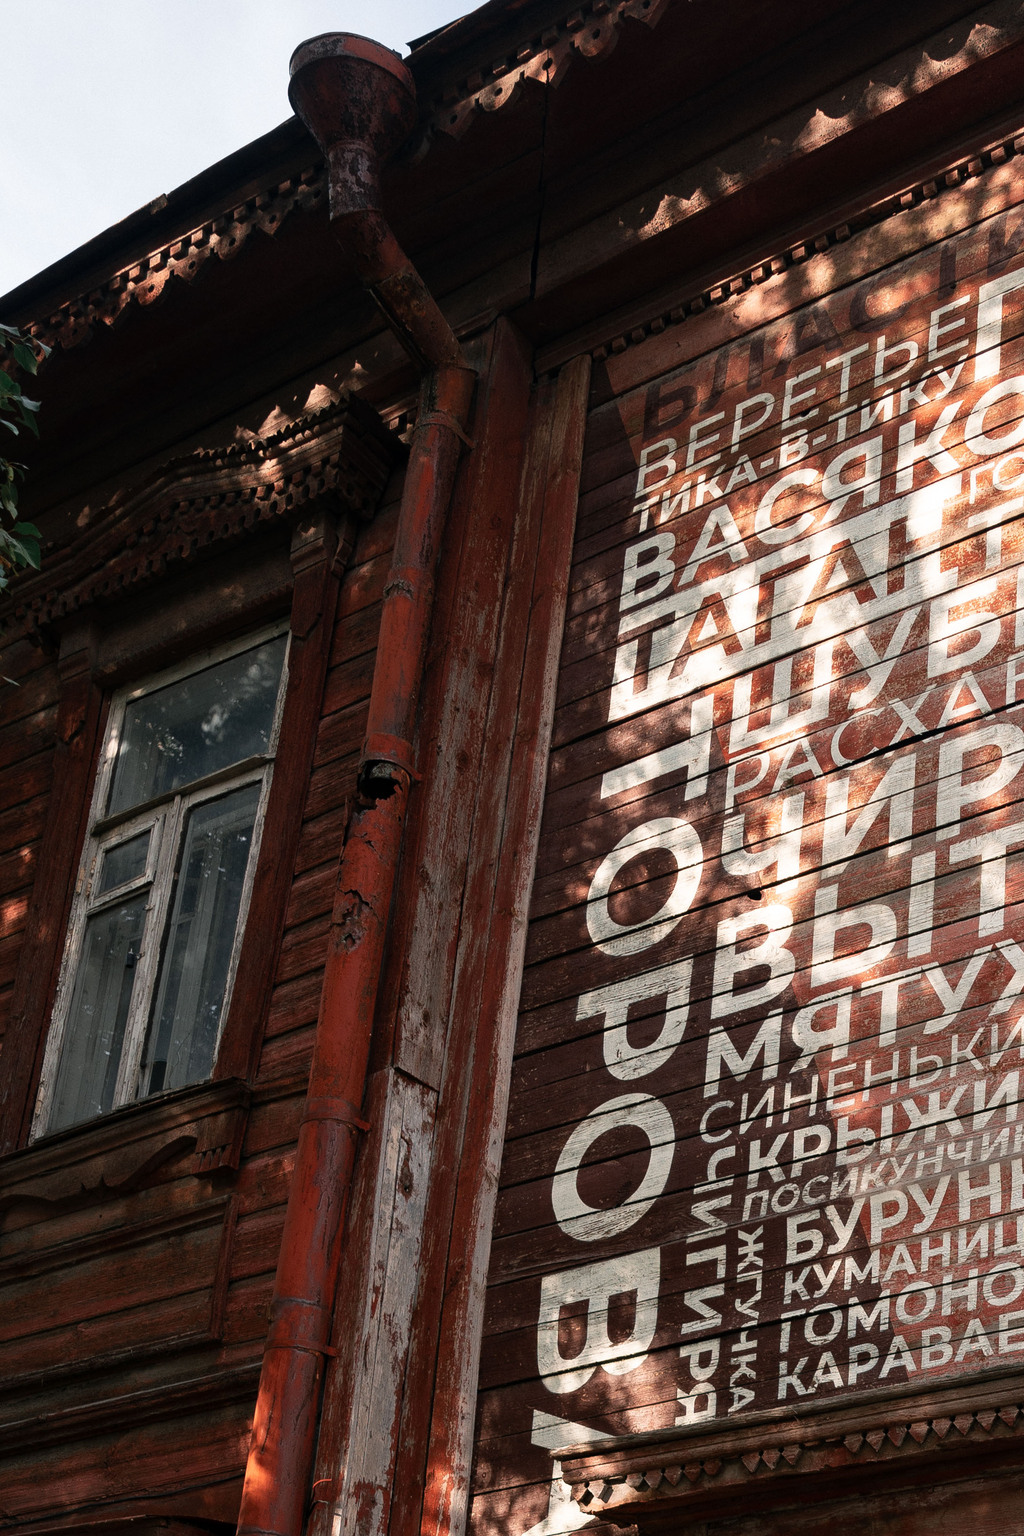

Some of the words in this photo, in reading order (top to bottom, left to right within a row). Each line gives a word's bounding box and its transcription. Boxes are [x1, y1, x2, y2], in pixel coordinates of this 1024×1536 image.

[630, 354, 966, 532] ТИКА-В-ТИКУ
[633, 292, 973, 500] ВЕРЕТЬЕ
[675, 1146, 742, 1426] ЧИГИРЯ
[727, 1229, 764, 1413] ЖГУЧКА
